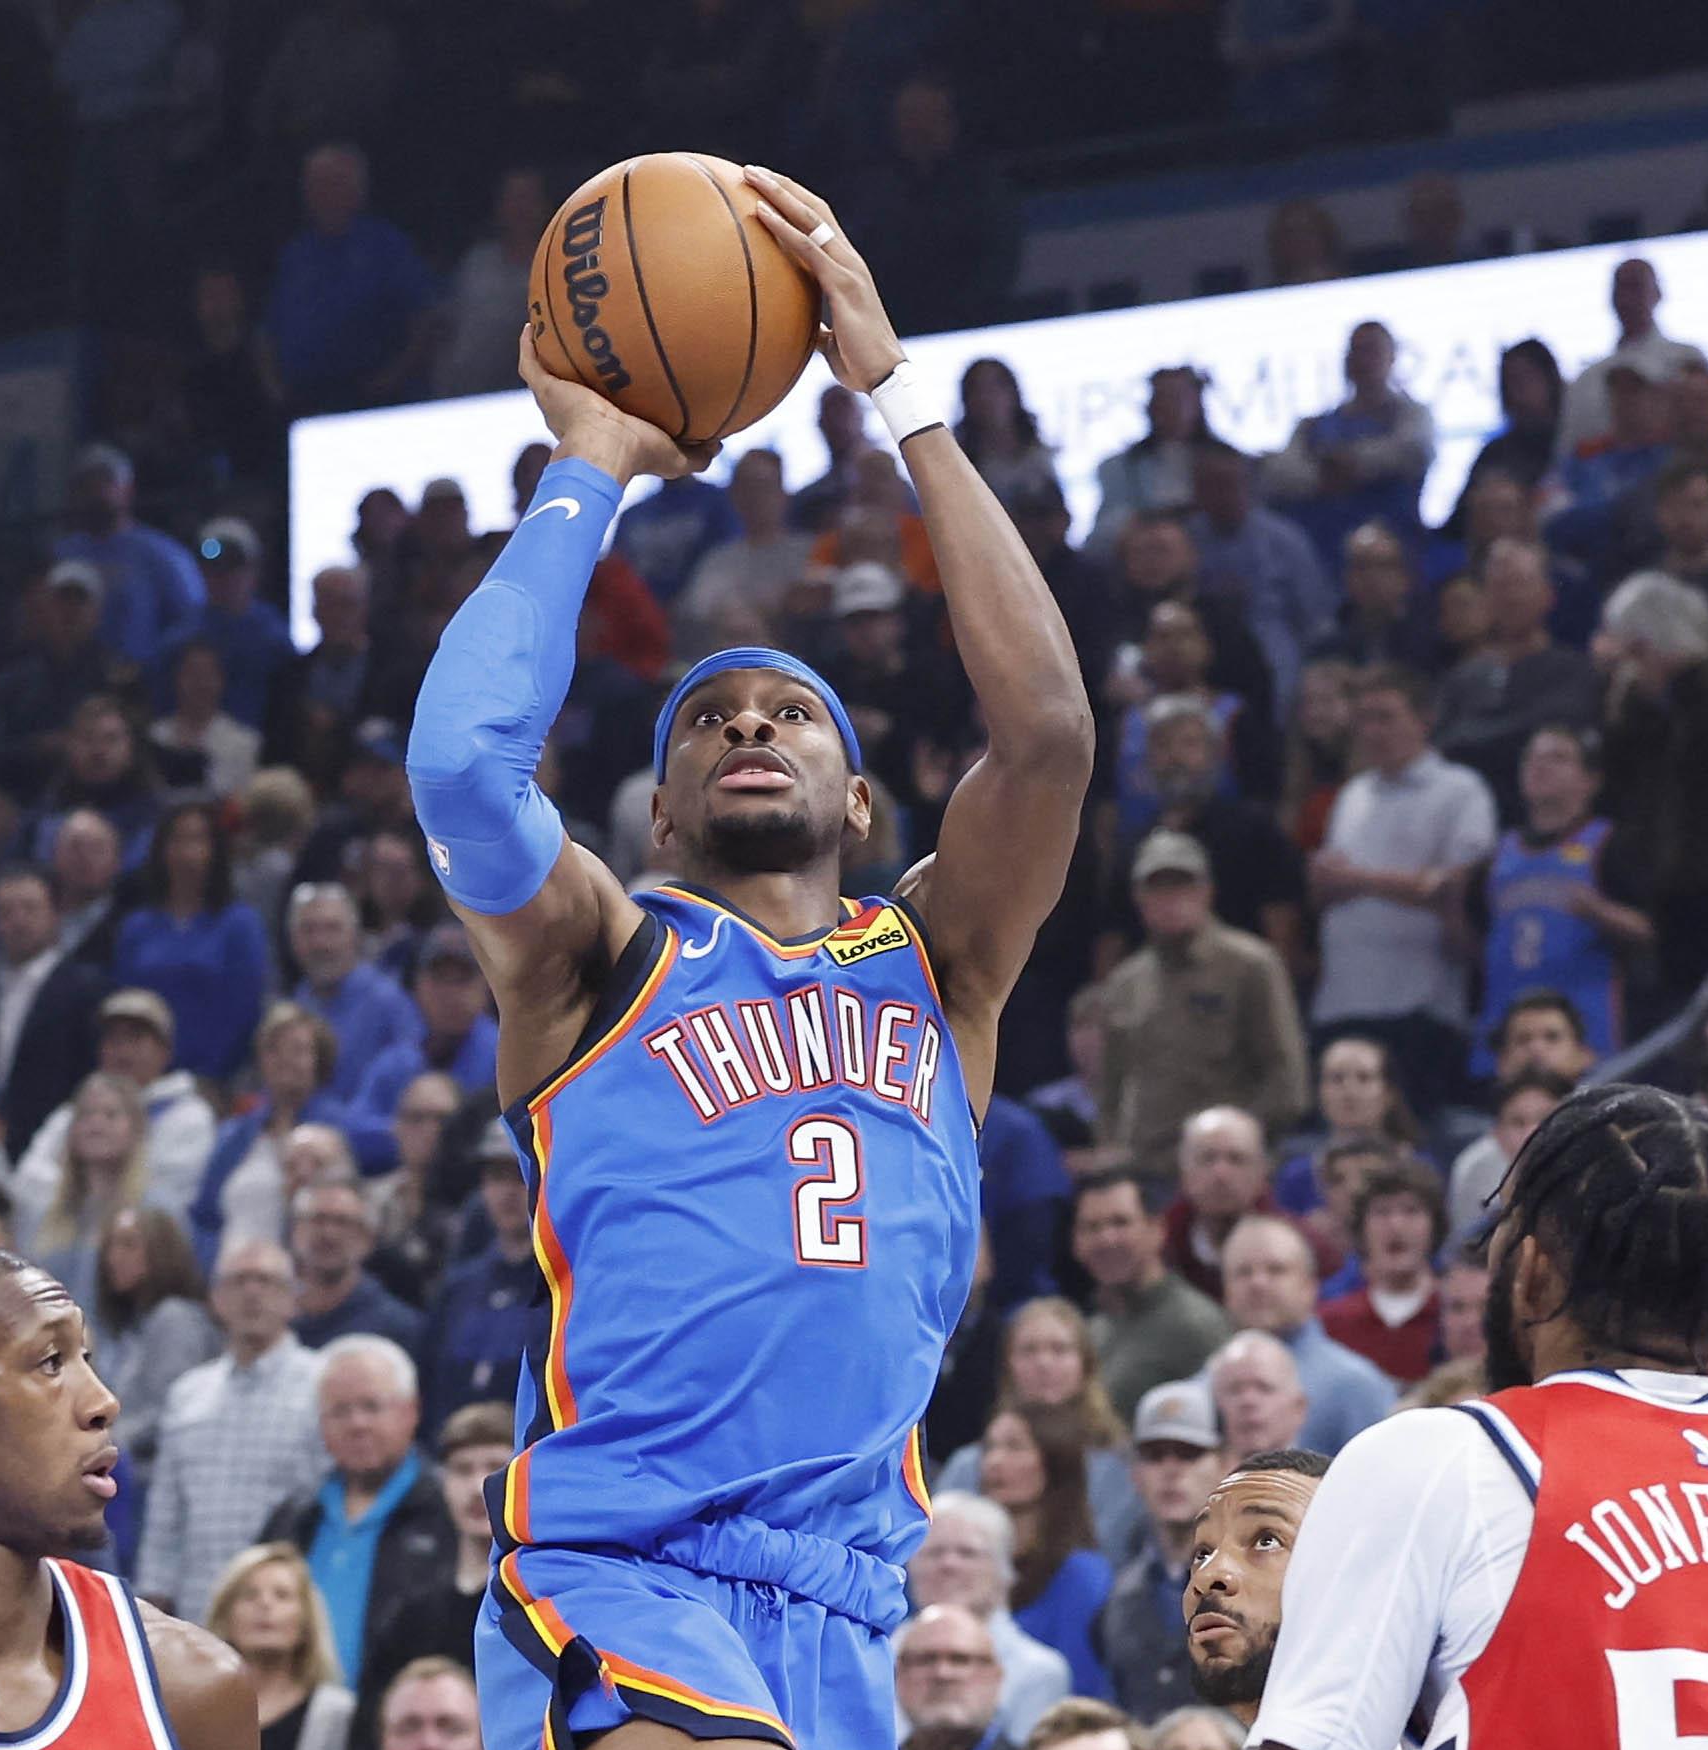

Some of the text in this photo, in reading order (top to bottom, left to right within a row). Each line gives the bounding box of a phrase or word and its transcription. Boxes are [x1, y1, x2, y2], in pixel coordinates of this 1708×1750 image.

[561, 194, 630, 394] Wilson
[641, 984, 940, 1127] THUNDER
[788, 1113, 869, 1268] 2
